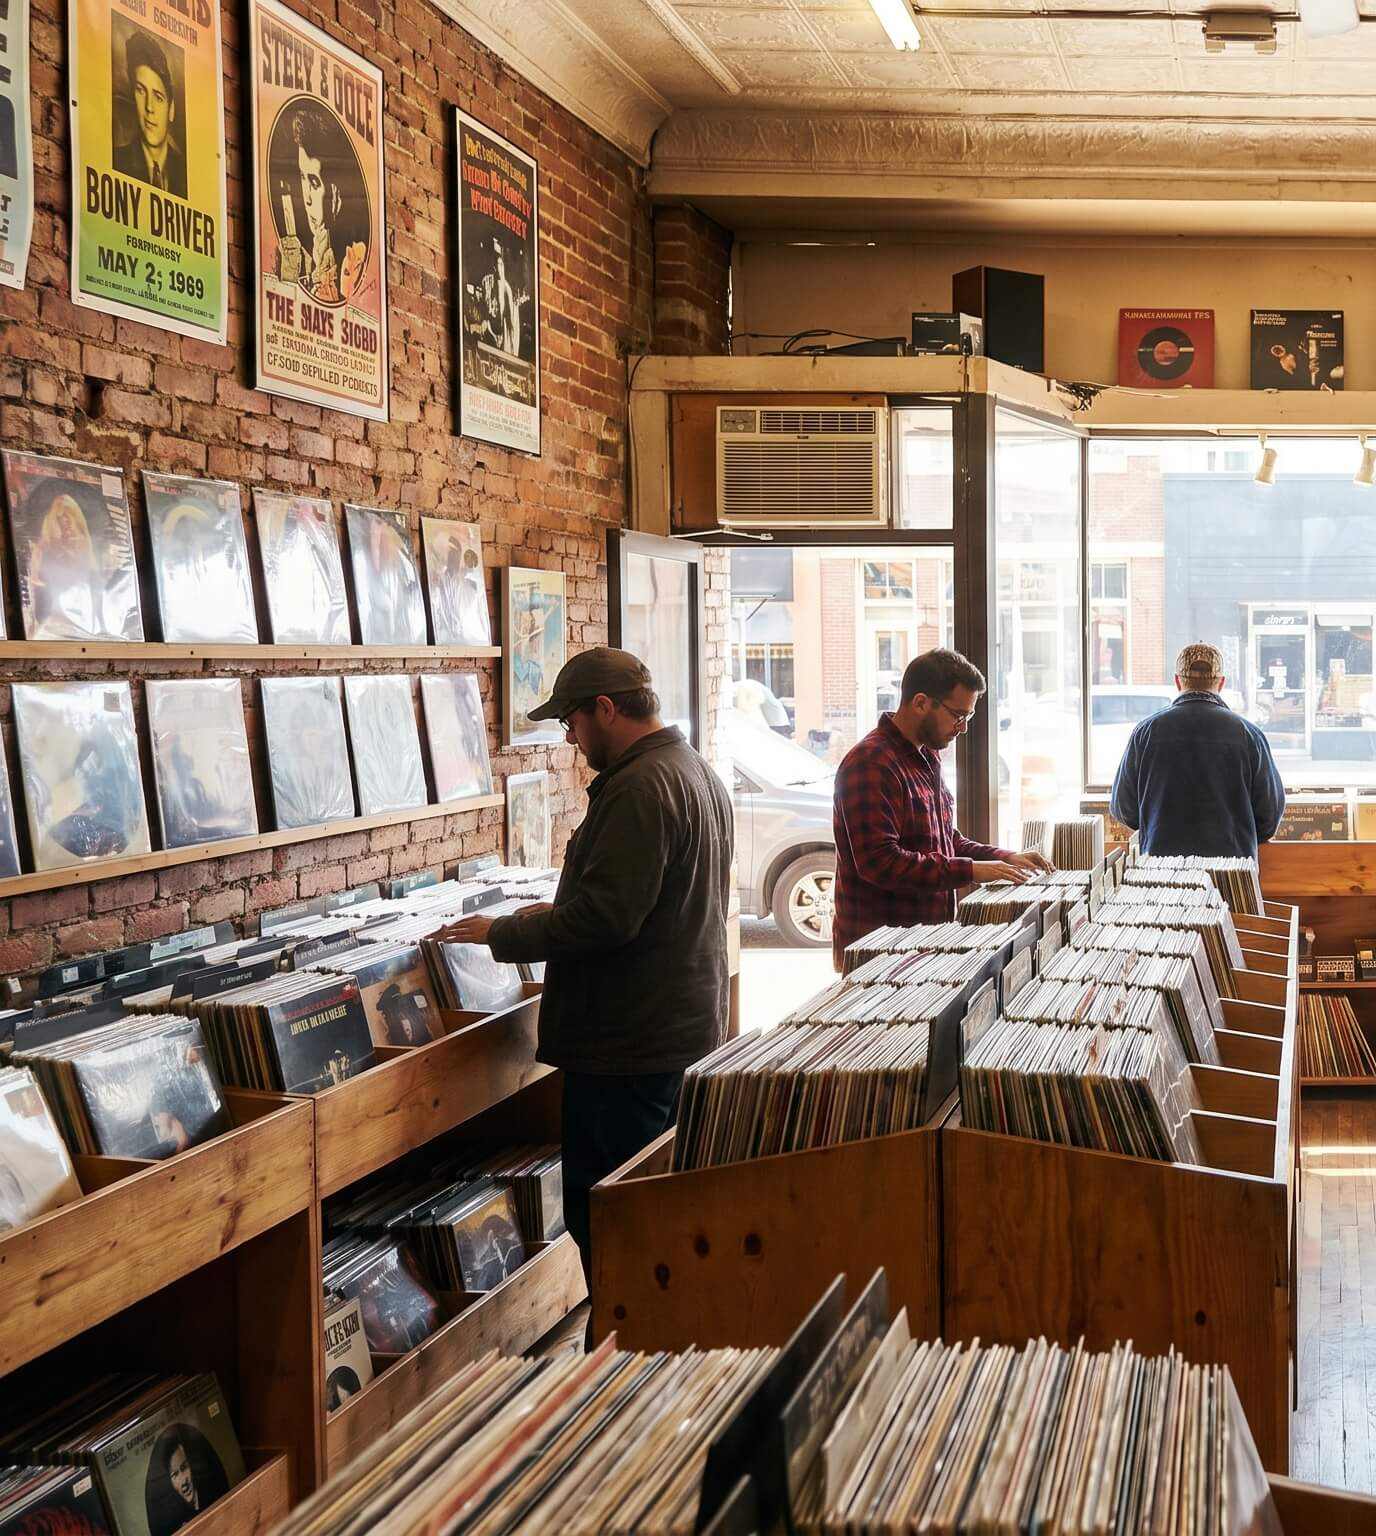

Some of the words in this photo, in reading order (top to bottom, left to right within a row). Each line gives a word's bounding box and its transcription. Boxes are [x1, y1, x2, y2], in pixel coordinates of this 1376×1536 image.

[86, 165, 142, 230] BONY
[150, 192, 215, 258] DRIVER
[98, 246, 138, 278] MAY
[169, 270, 204, 300] 1969
[266, 291, 294, 326] THE
